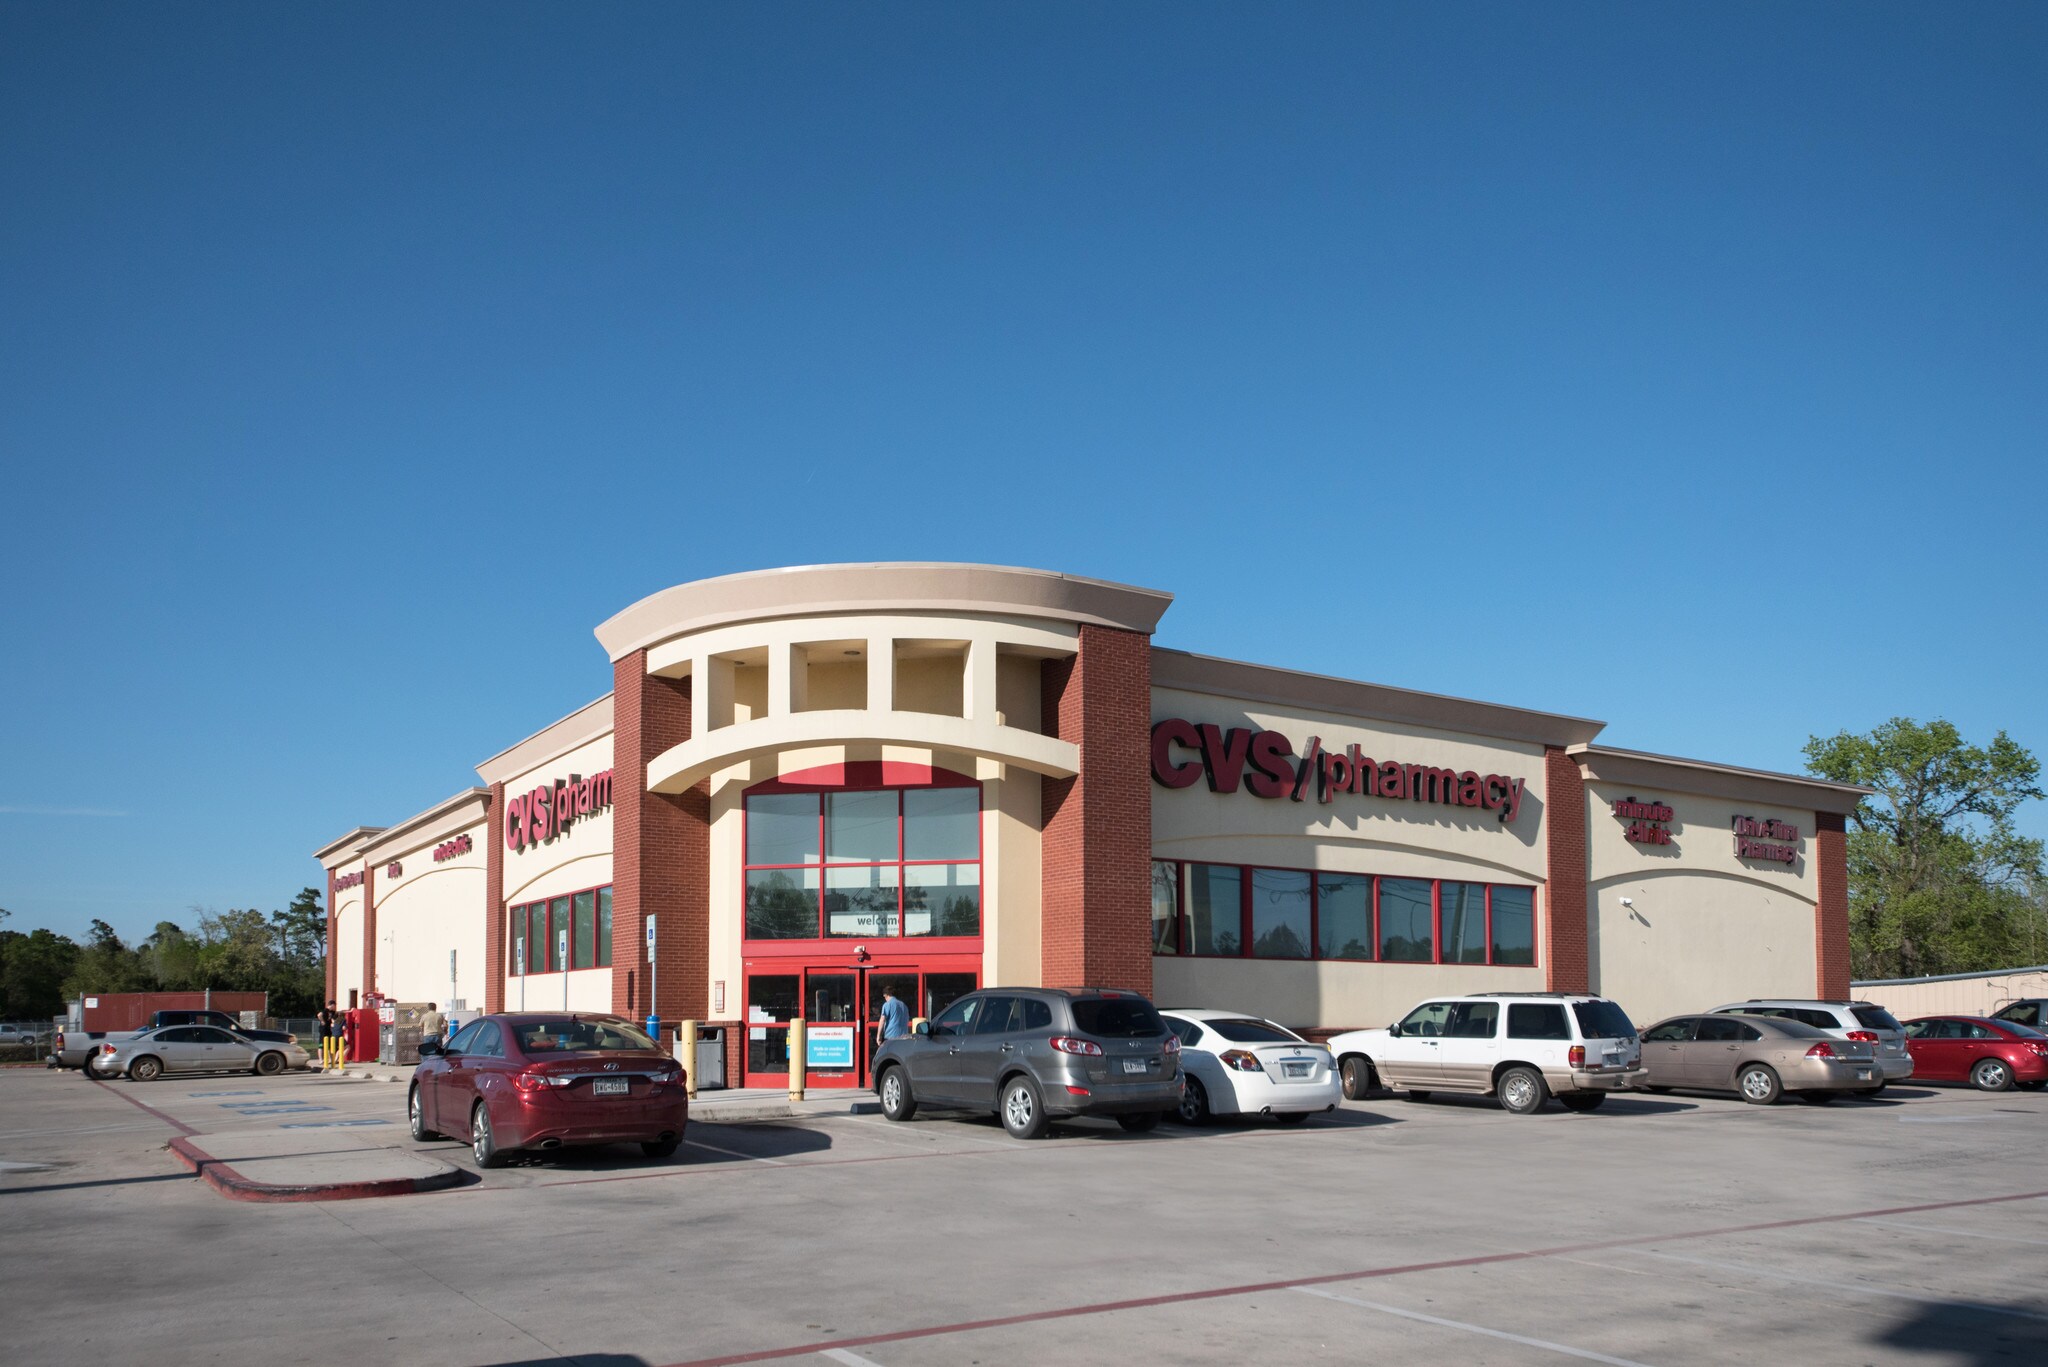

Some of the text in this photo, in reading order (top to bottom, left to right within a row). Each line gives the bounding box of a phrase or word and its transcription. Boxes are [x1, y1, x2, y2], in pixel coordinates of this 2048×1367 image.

[1151, 718, 1525, 823] CVS/pharmacy
[1615, 797, 1674, 822] minute
[1627, 821, 1671, 845] clinic
[1734, 837, 1798, 866] Pharmacy
[857, 914, 900, 926] welcom
